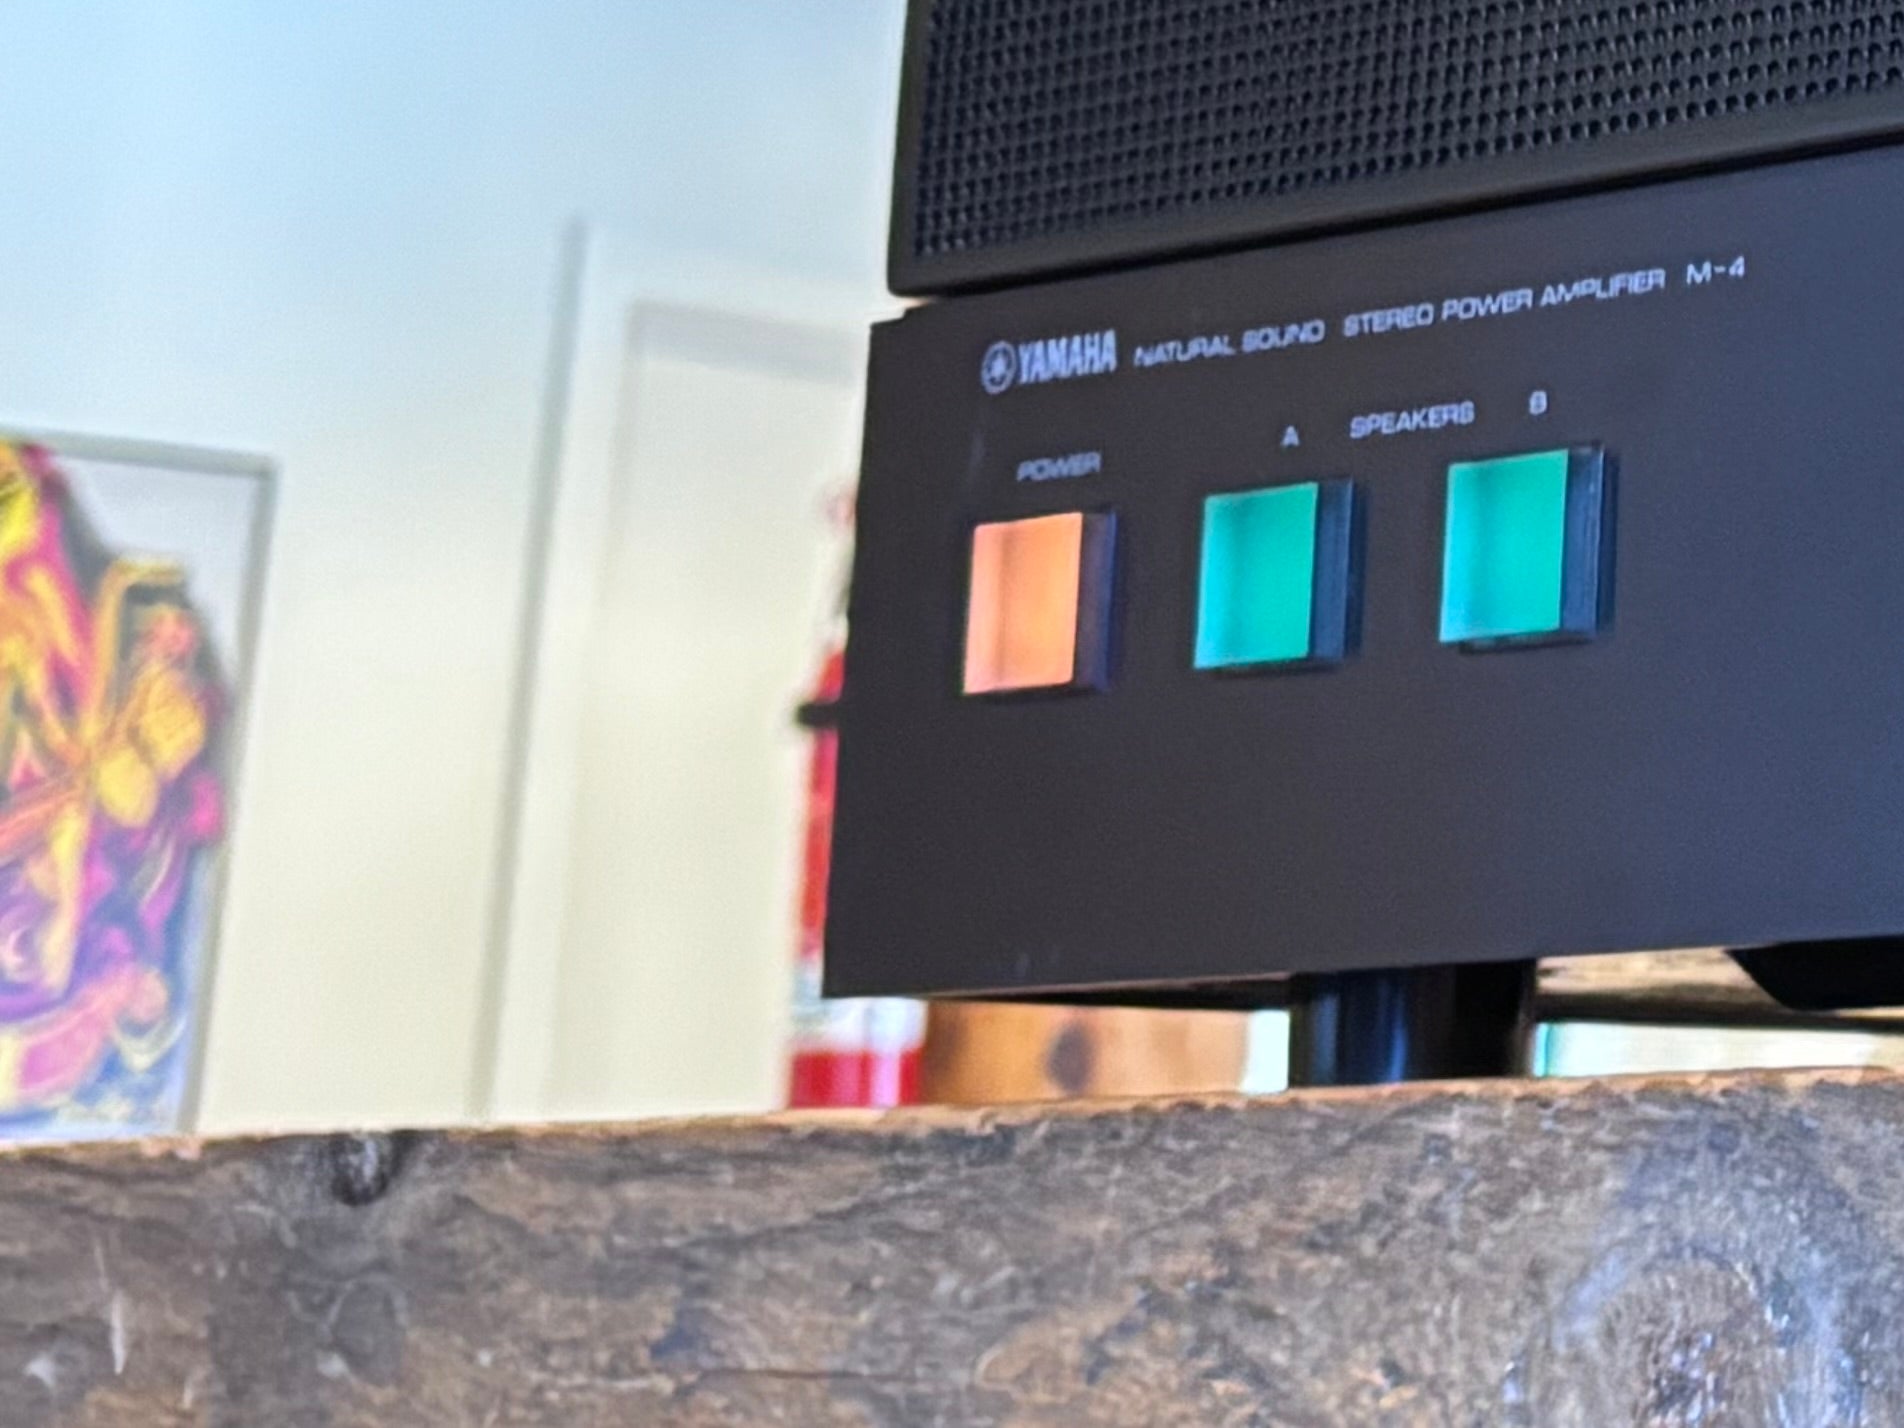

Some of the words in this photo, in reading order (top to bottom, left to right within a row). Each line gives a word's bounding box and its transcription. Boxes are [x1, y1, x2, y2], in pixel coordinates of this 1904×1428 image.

[1018, 328, 1118, 385] YAMAHA
[1133, 331, 1236, 367] NATURAL
[1241, 318, 1325, 353] SOUND
[1343, 304, 1434, 337] STEREO
[1441, 288, 1533, 322] POWER
[1540, 267, 1667, 308] AMPLIFIER
[1686, 255, 1746, 287] M-4
[1281, 425, 1300, 448] A
[1349, 401, 1476, 439] SPEAKERS
[1529, 390, 1549, 417] B
[1016, 450, 1102, 484] POWER
